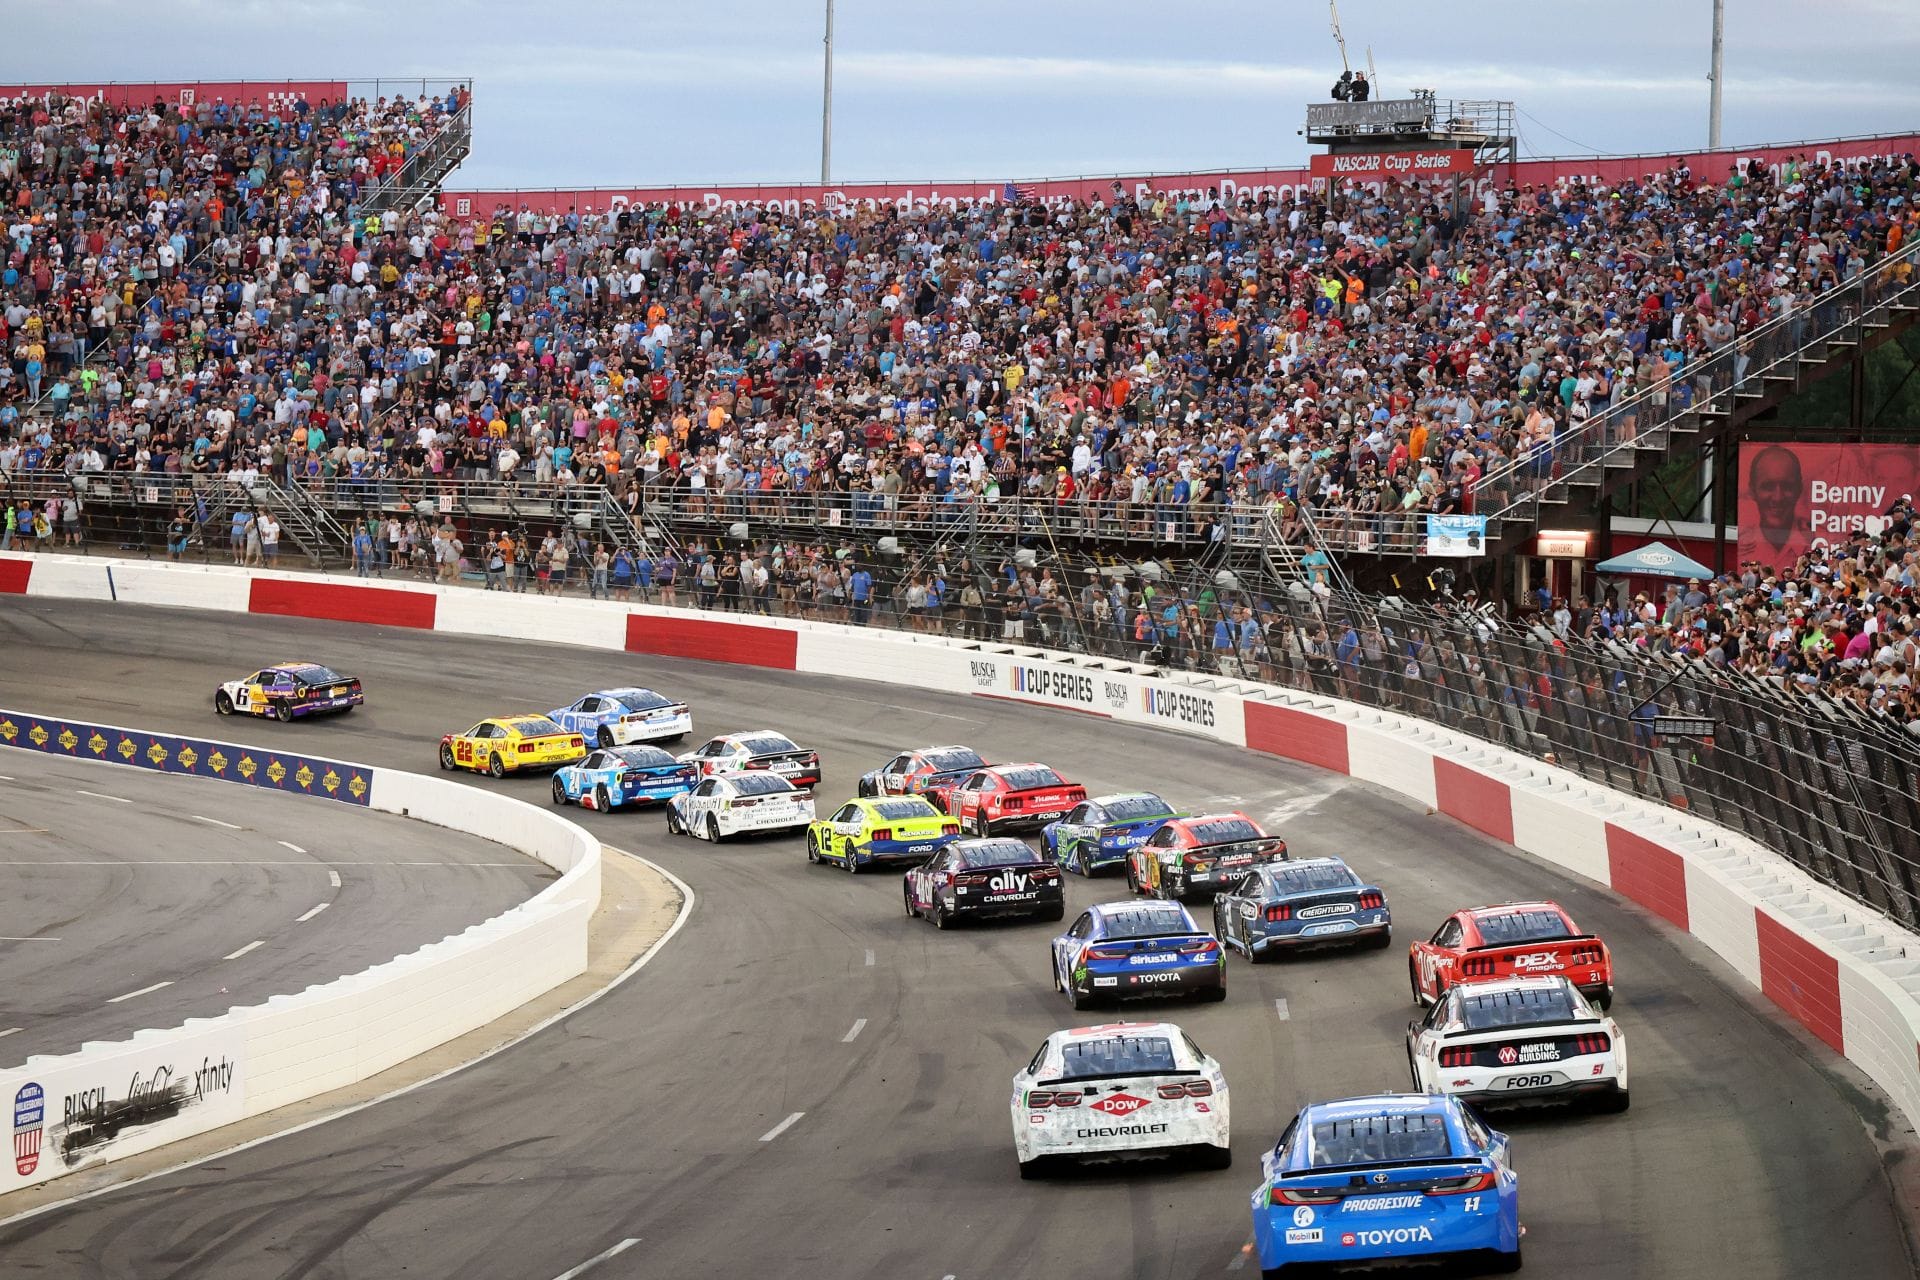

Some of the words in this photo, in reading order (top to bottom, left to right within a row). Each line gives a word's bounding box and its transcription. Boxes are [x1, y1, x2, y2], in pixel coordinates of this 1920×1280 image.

[1333, 156, 1381, 172] NASCAR
[1385, 155, 1411, 172] Cup
[1415, 153, 1452, 168] Series
[458, 201, 469, 214] EE
[148, 488, 157, 501] EE
[1811, 480, 1886, 508] Benny
[441, 497, 452, 509] DD
[1432, 516, 1461, 528] SAVE
[1811, 509, 1893, 533] Parson
[970, 660, 996, 678] BUSCH
[978, 678, 992, 687] LIGHT
[1027, 668, 1050, 695] CUP
[1053, 671, 1093, 702] SERIES
[235, 687, 249, 705] 6
[1104, 681, 1128, 702] BUSCH
[332, 699, 348, 707] FORD
[1156, 689, 1178, 718] CUP
[1180, 693, 1215, 727] SERIES
[577, 716, 598, 730] prime
[648, 724, 680, 733] CHEVROLET
[30, 730, 48, 740] SUNOCO
[59, 734, 78, 745] SUNOCO
[89, 738, 107, 749] SUNOCO
[118, 743, 137, 754] SUNOCO
[148, 748, 167, 759] SUNOCO
[178, 752, 197, 763] SUNOCO
[457, 740, 472, 763] 22
[208, 756, 227, 768] SUNOCO
[238, 761, 257, 772] SUNOCO
[267, 766, 286, 778] SUNOCO
[296, 771, 314, 783] SUNOCO
[323, 776, 341, 787] SUNOCO
[349, 780, 367, 792] SUNOCO
[569, 772, 580, 794] 24
[756, 816, 797, 825] CHEVROLET
[1037, 812, 1061, 820] FORD
[820, 827, 833, 852] 12
[908, 845, 933, 853] FORD
[1221, 853, 1253, 862] TRACKER
[1137, 852, 1147, 883] 19
[990, 872, 1027, 892] ally
[984, 891, 1038, 903] CHEVROLET
[1302, 905, 1350, 917] FREIGHTLINER
[1373, 915, 1381, 924] 2
[1314, 923, 1345, 935] FORD
[1130, 953, 1178, 965] SiriusXM
[1514, 952, 1559, 968] DEX
[1526, 962, 1565, 971] imaging
[1139, 973, 1181, 983] TOYOTA
[1590, 973, 1601, 982] 21
[1520, 1042, 1556, 1054] MORTON
[1519, 1050, 1560, 1063] BUILDINGS
[1592, 1064, 1604, 1075] 51
[195, 1055, 234, 1101] xfinity
[1507, 1075, 1553, 1088] FORD
[64, 1086, 106, 1128] BUSCH
[1104, 1100, 1140, 1111] DOW
[1194, 1102, 1211, 1112] 3
[1352, 1115, 1406, 1125] HAMLIN
[1077, 1123, 1169, 1138] CHEVROLET
[1341, 1195, 1424, 1213] PROGRESSIVE
[1464, 1196, 1481, 1212] 11
[1289, 1232, 1311, 1241] Mobil
[1357, 1225, 1433, 1246] TOYOTA
